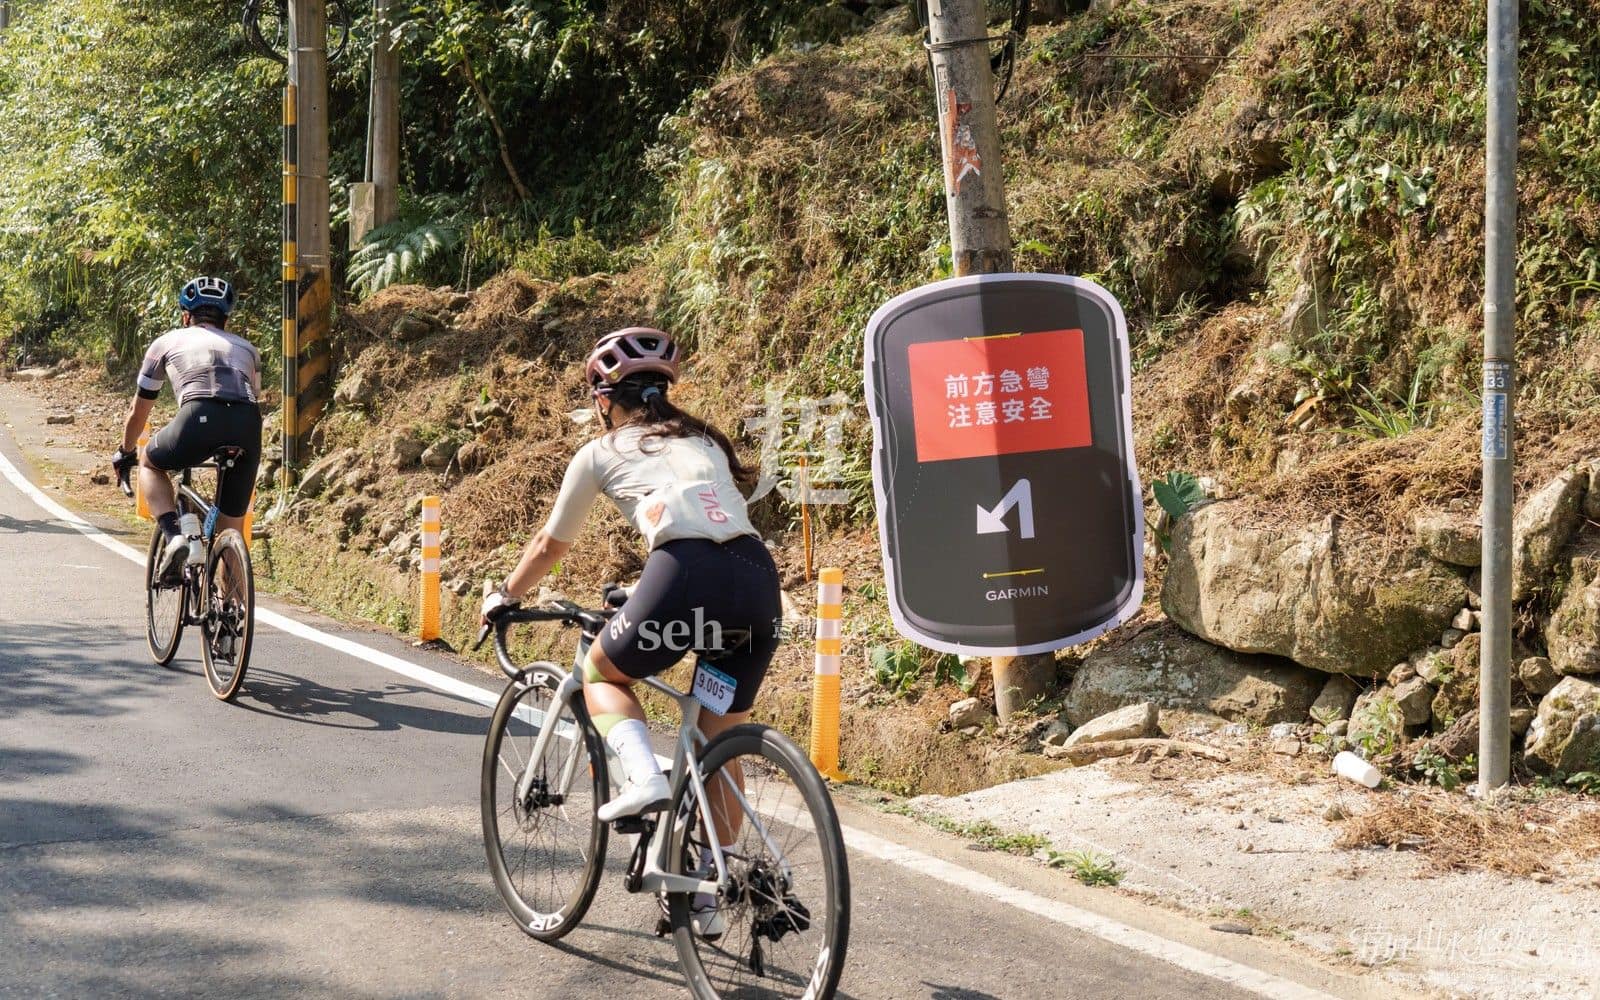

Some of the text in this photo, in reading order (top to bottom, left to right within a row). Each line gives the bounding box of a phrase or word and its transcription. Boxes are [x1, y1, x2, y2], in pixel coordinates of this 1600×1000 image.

[944, 367, 1050, 399] 前方急彎
[947, 396, 1053, 428] 注意安全
[698, 487, 728, 523] GVL
[985, 585, 1049, 602] GARMIN
[610, 612, 631, 640] GVL
